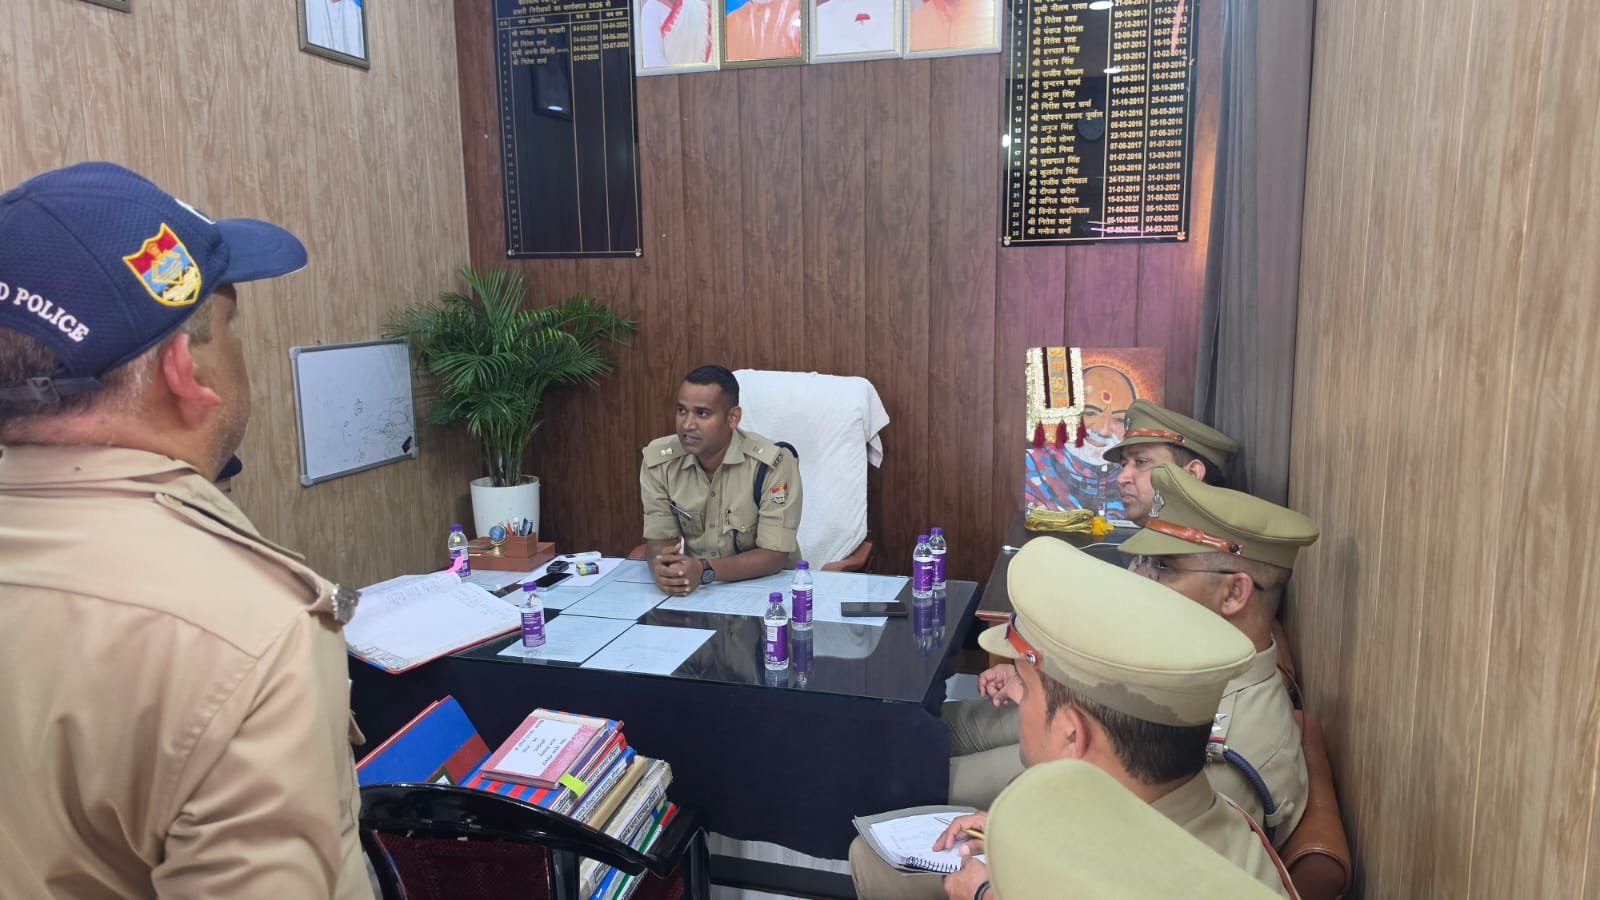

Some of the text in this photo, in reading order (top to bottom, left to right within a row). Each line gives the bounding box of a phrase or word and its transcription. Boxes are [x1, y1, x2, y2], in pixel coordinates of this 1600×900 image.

[1033, 16, 1042, 24] श्री
[1033, 27, 1041, 35] श्री
[1033, 37, 1041, 45] श्री
[1033, 47, 1041, 55] श्री
[1032, 58, 1040, 66] श्री
[1032, 70, 1040, 78] श्री
[1032, 80, 1040, 88] श्री
[1152, 71, 1185, 80] 10-01-2015
[1031, 91, 1039, 99] श्री
[1030, 102, 1039, 110] श्री
[1030, 113, 1039, 121] श्री
[1030, 124, 1038, 132] श्री
[1030, 136, 1038, 144] श्री
[1030, 146, 1038, 154] श्री
[1029, 168, 1037, 176] श्री
[1029, 178, 1037, 186] श्री
[1029, 187, 1037, 195] श्री
[13, 287, 90, 342] POLICE
